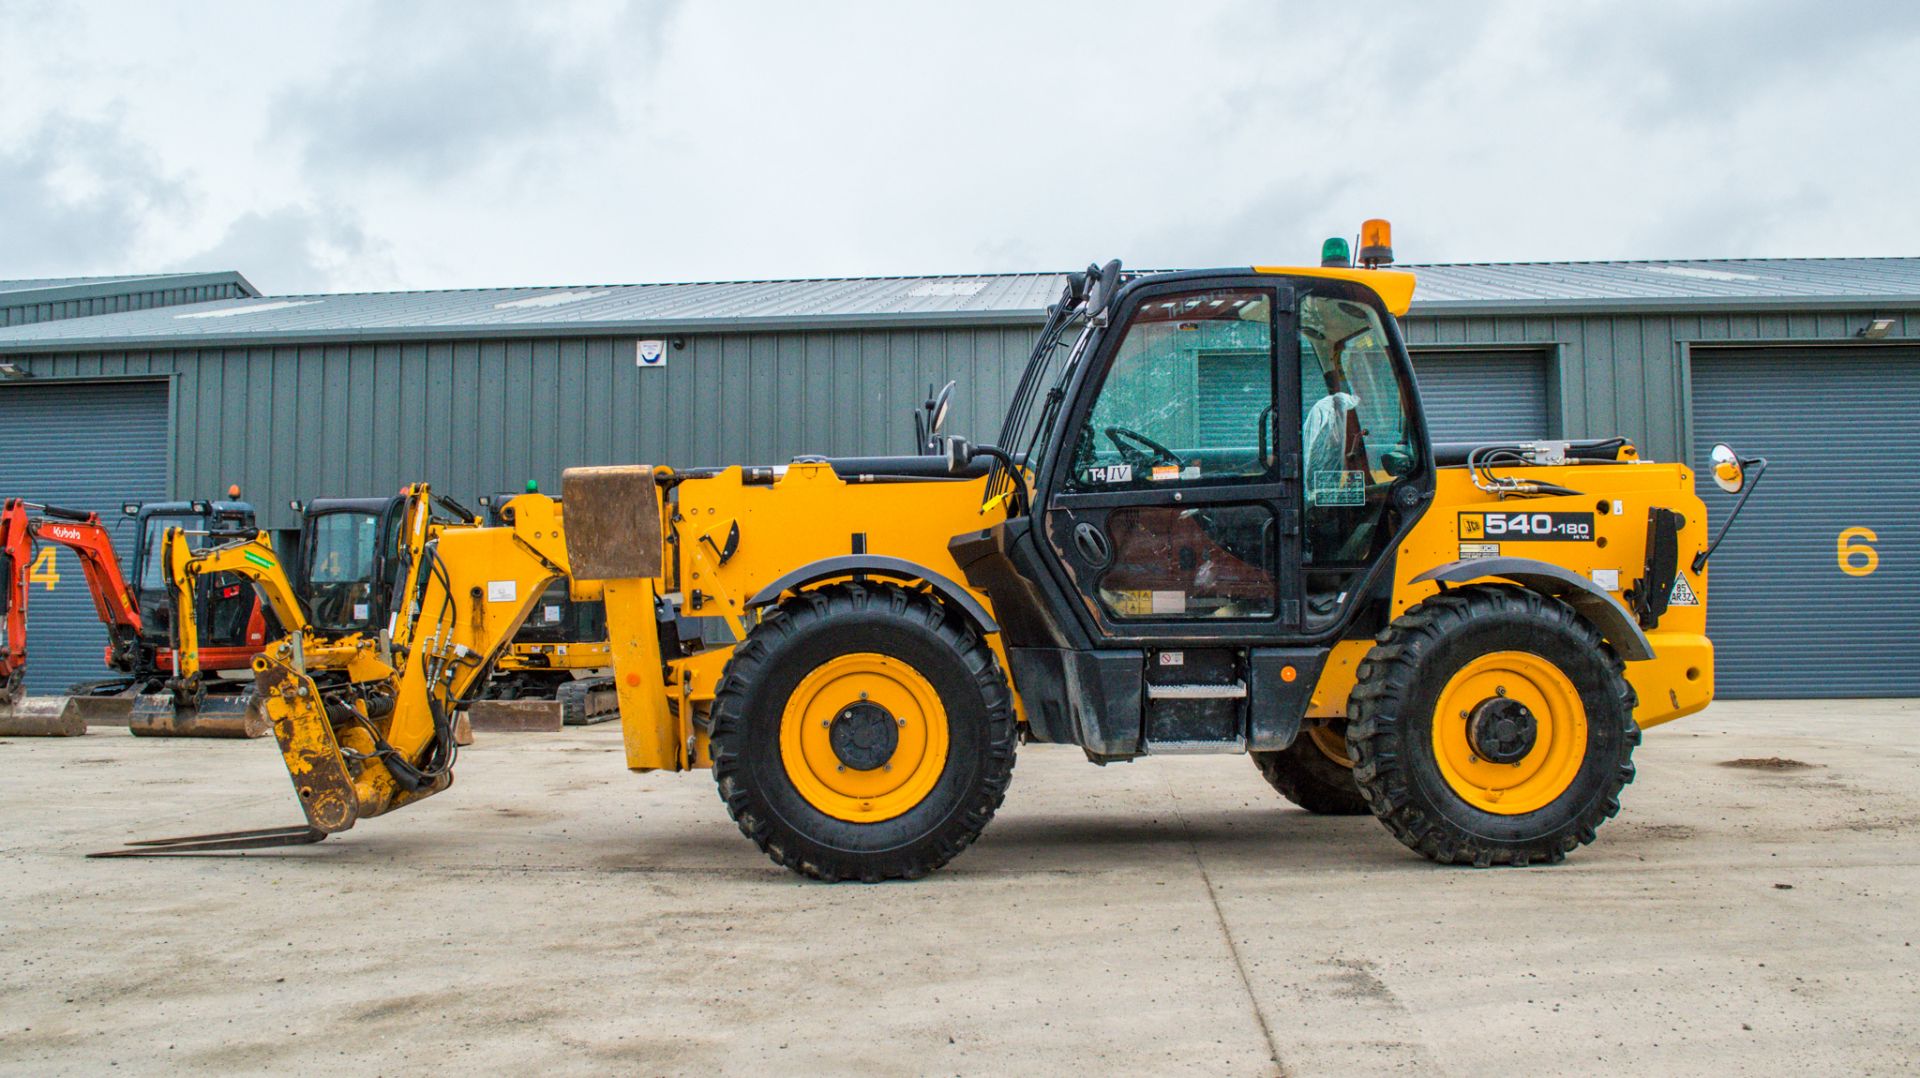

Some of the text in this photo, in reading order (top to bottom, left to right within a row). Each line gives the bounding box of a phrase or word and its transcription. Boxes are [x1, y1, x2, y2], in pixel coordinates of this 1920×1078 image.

[1089, 467, 1128, 481] T4 IV
[53, 526, 80, 540] Kubota
[1484, 514, 1589, 534] 540-180
[1837, 526, 1879, 576] 6
[30, 546, 60, 591] 4
